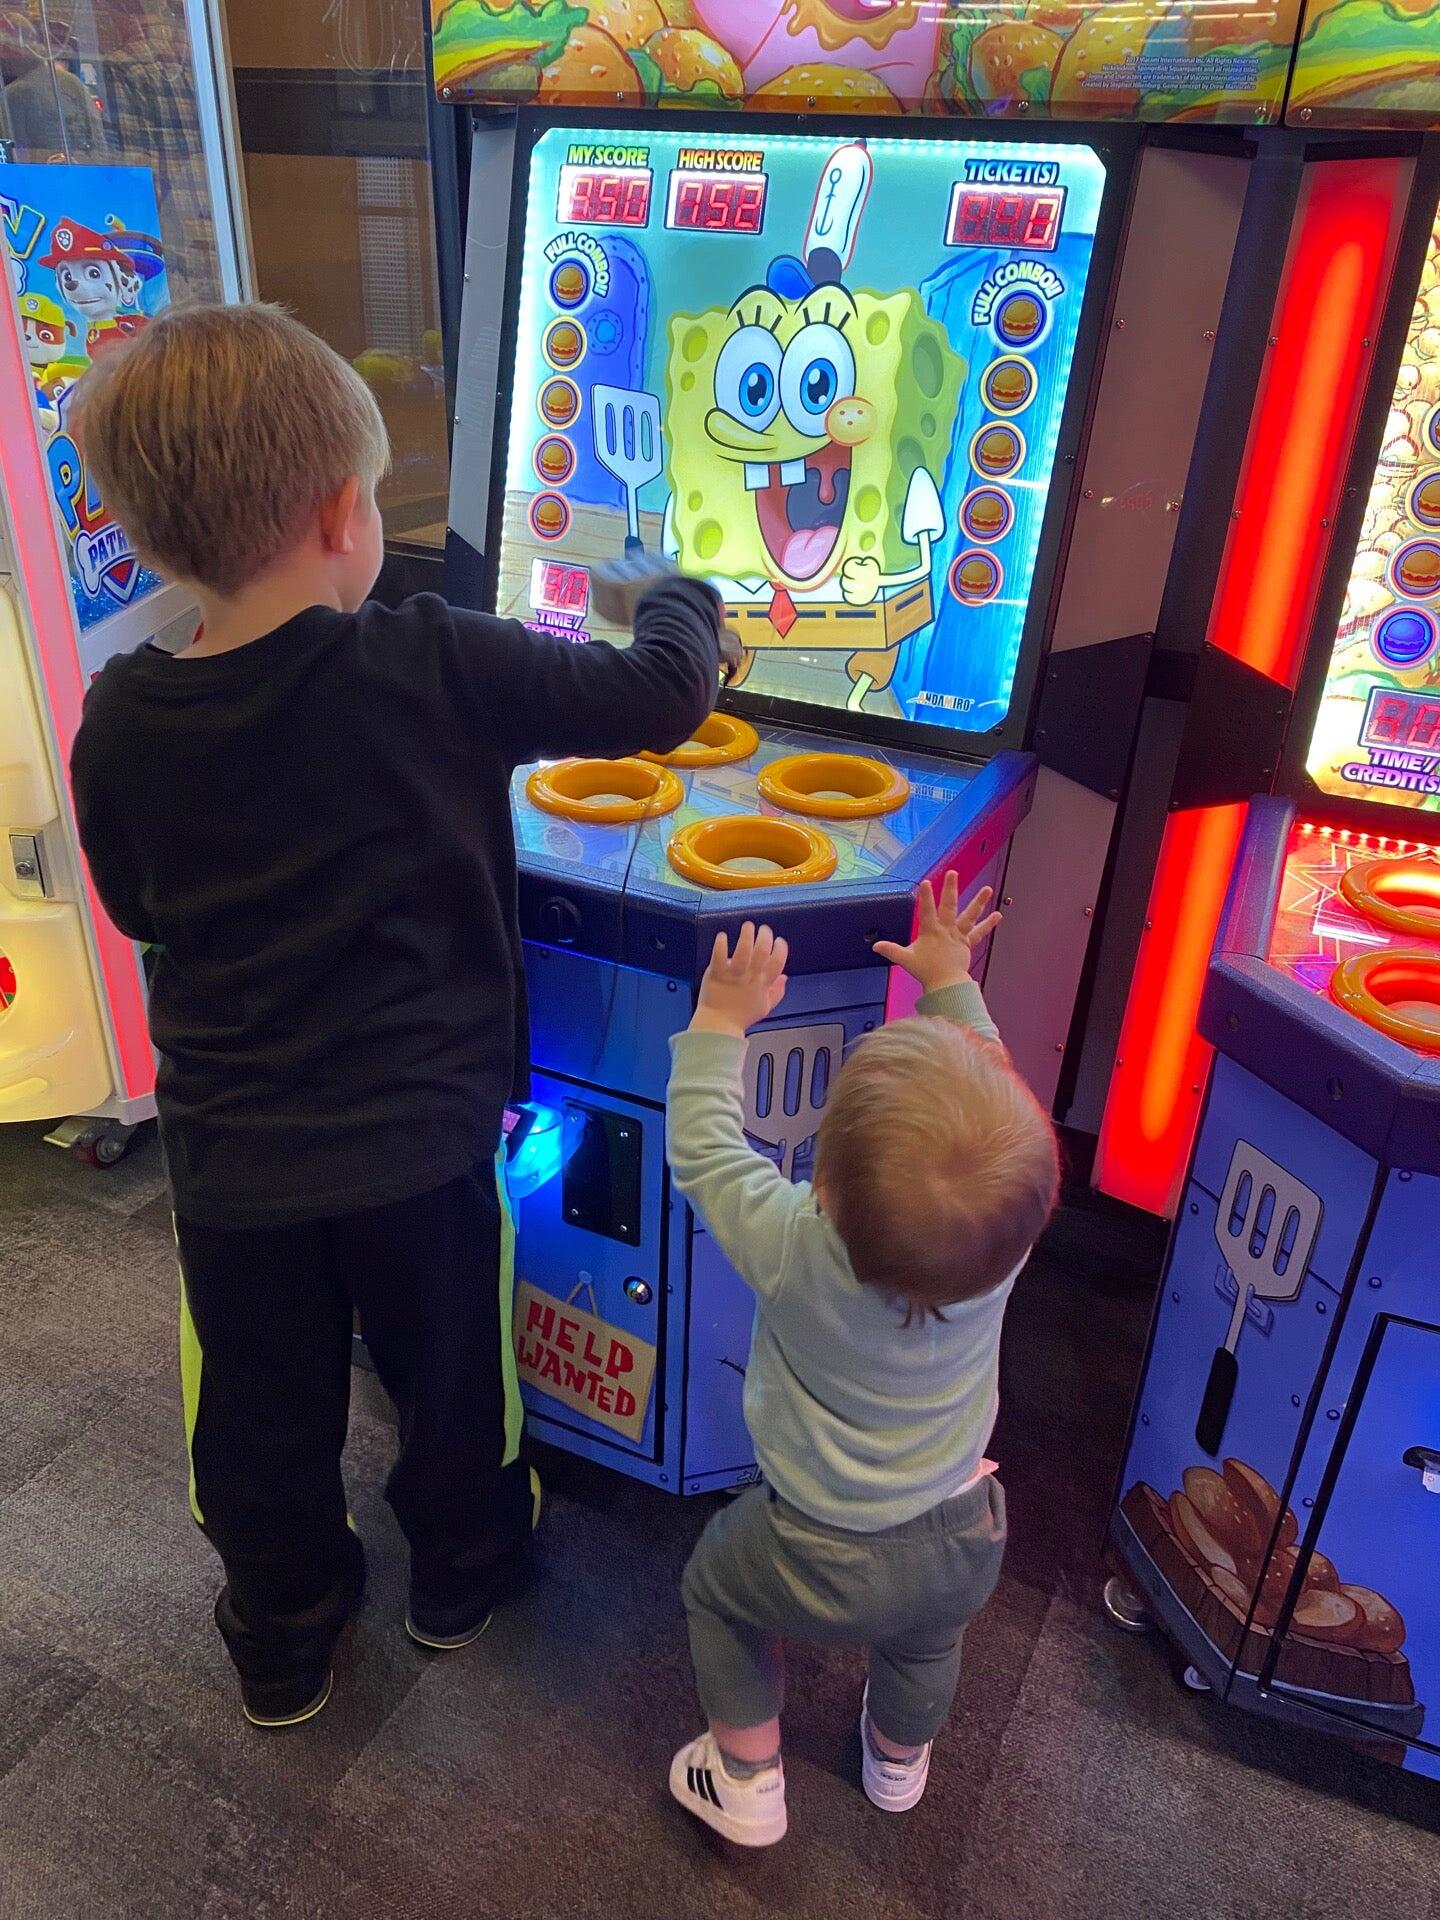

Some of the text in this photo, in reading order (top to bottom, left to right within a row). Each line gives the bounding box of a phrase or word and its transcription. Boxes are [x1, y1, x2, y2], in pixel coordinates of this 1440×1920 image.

[568, 145, 650, 167] MY SCORE
[678, 149, 764, 171] HIGH SCORE
[965, 160, 1060, 185] TICKET(S)
[571, 177, 649, 222] 950
[680, 183, 762, 228] 752
[545, 231, 577, 262] FULL
[972, 279, 998, 326] FULL
[87, 526, 129, 571] PATR
[537, 609, 584, 631] TIME/
[1369, 748, 1439, 773] TIME/
[1342, 763, 1440, 794] CREDIT(S
[526, 1300, 634, 1380] HELP
[517, 1335, 636, 1417] WANTED
